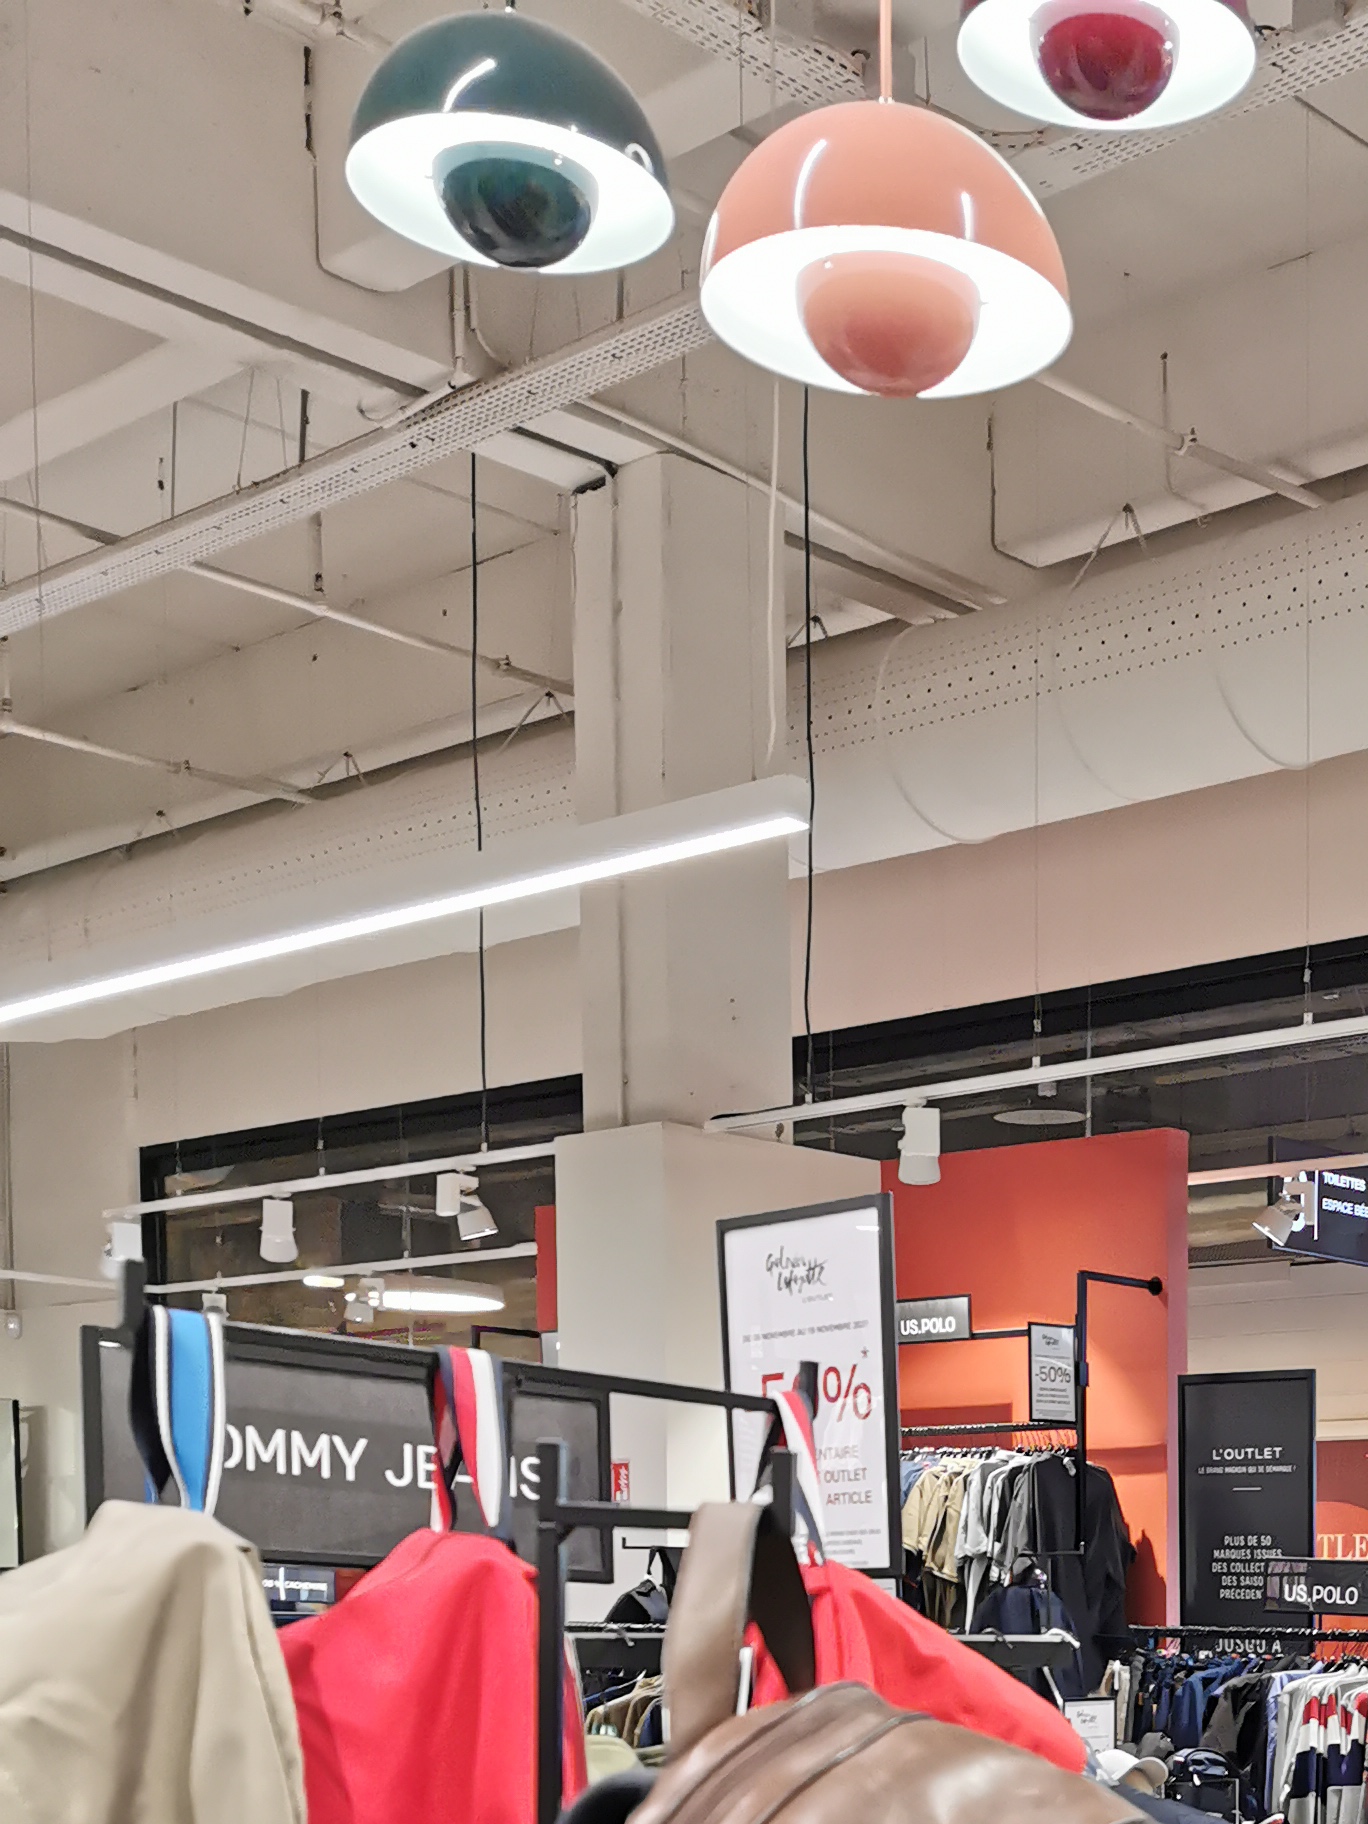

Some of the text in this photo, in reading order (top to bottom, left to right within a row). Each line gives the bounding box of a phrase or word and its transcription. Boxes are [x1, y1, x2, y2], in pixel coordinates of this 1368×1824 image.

[1322, 1171, 1367, 1192] TOILETTES
[1321, 1198, 1354, 1216] ESPACE
[900, 1316, 956, 1336] US.POLO
[1212, 1447, 1283, 1461] L'OUTLET
[824, 1467, 868, 1484] OUTLET
[826, 1490, 873, 1505] ARTICLE
[1224, 1535, 1272, 1547] PLUS DE 50
[1213, 1548, 1252, 1560] MARQUES
[1212, 1562, 1266, 1573] DES COLLECT
[1221, 1575, 1265, 1586] DES SAISO
[1283, 1584, 1359, 1605] US.POLO
